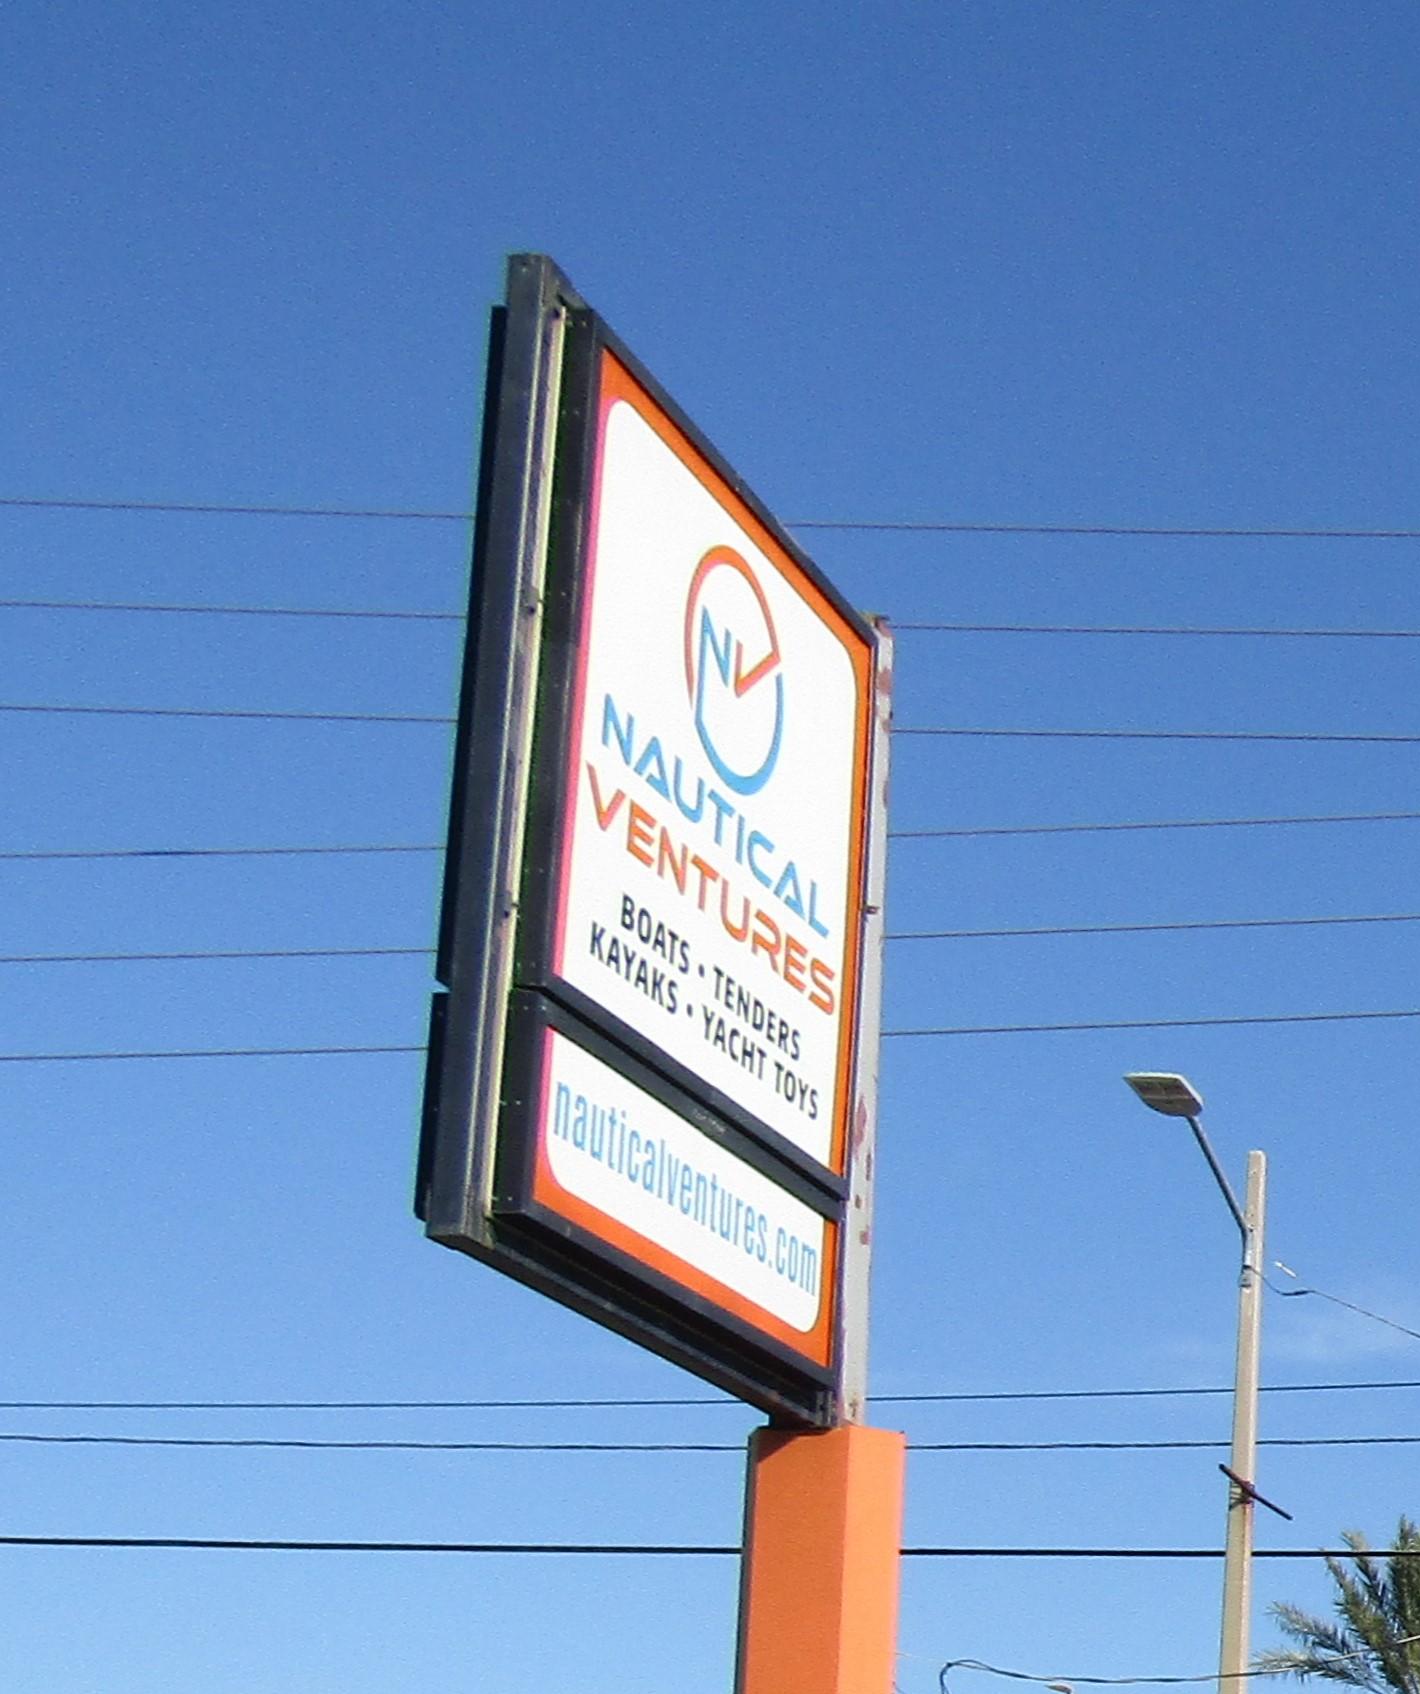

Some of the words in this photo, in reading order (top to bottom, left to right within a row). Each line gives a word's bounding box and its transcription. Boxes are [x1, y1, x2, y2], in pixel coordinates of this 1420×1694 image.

[586, 761, 834, 1016] VENTURES
[602, 693, 829, 938] NAUTICAL
[589, 920, 678, 1015] KAYAKS
[702, 1004, 767, 1080] YACHT
[774, 1060, 818, 1120] TOYS
[620, 892, 690, 975] BOATS
[713, 964, 801, 1061] TENDERS
[554, 1081, 818, 1297] nauticalventures.com
